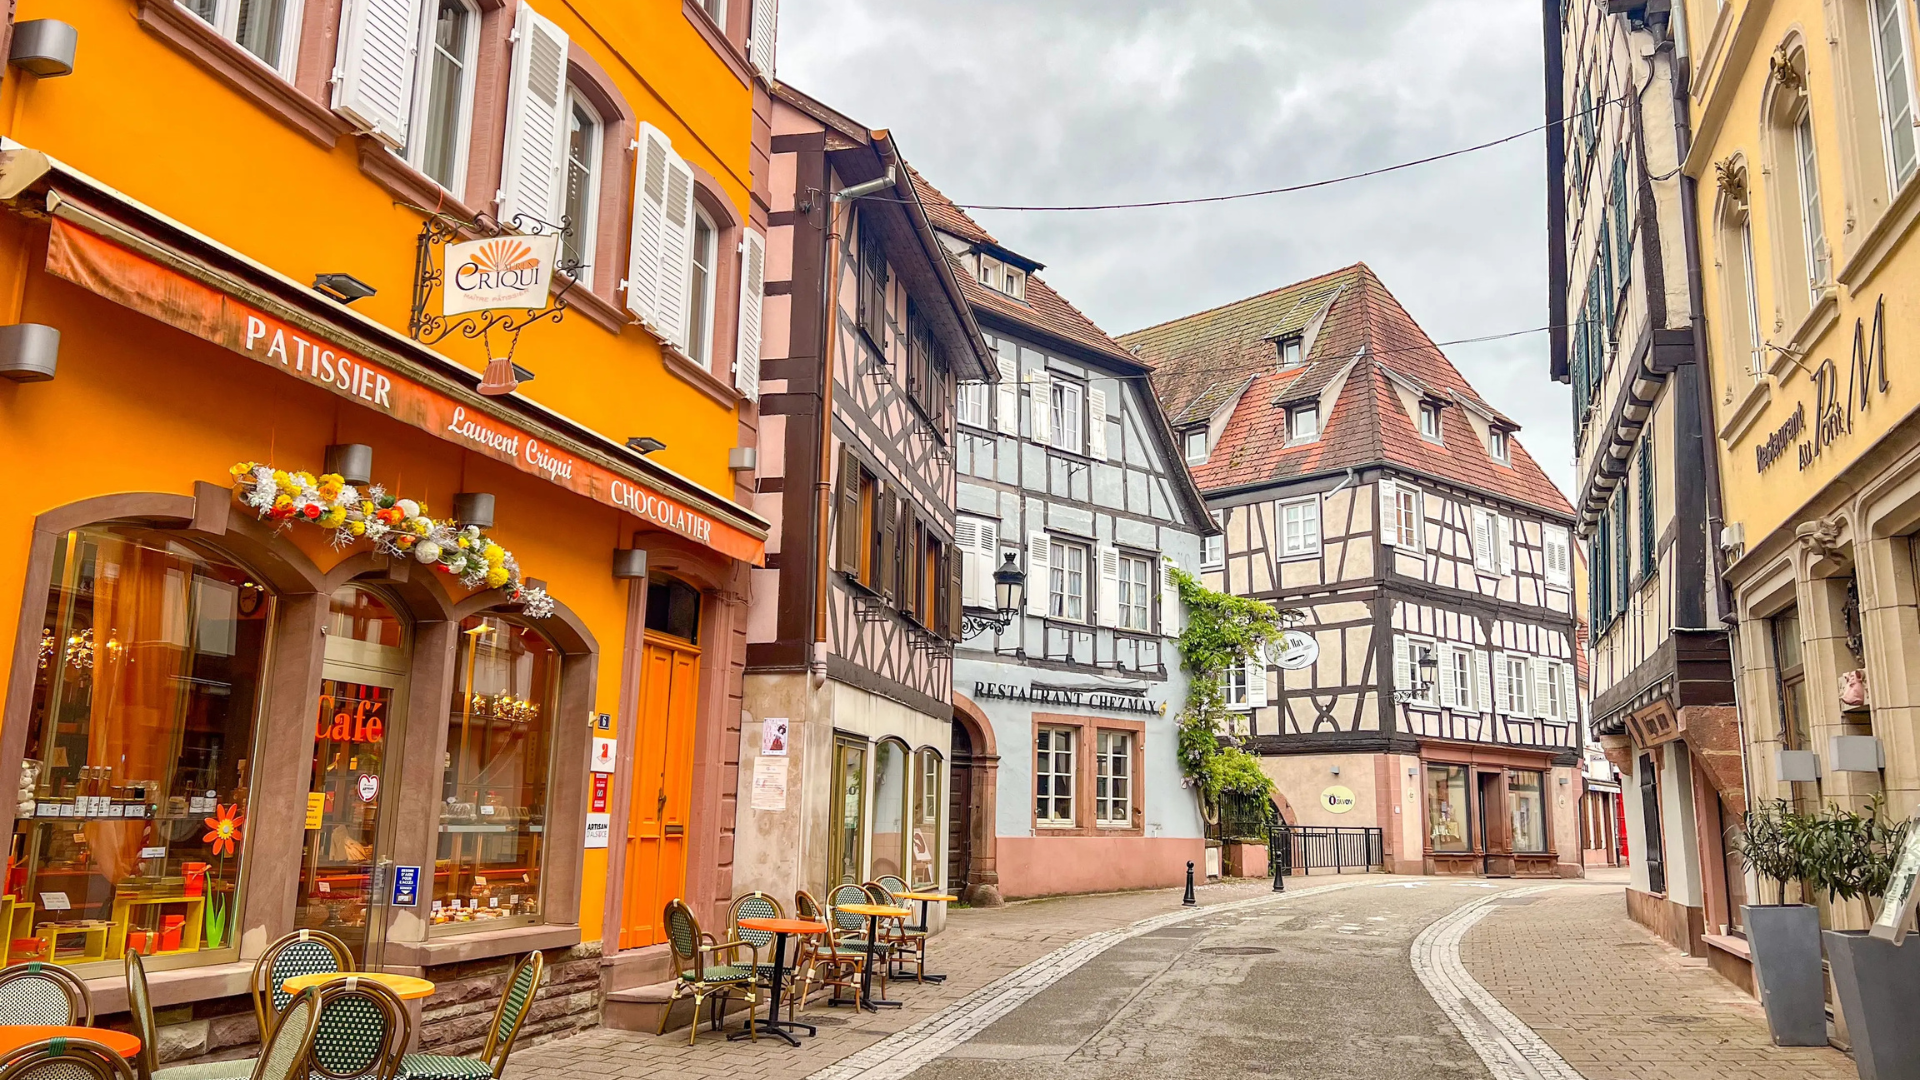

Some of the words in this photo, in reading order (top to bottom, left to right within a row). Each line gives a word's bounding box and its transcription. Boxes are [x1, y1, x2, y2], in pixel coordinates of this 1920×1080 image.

[455, 262, 540, 291] CRIQUI
[245, 315, 391, 409] PATISSIER
[447, 406, 519, 457] Laurent
[525, 439, 573, 480] Criqui
[1755, 401, 1806, 473] Restaurant
[610, 480, 711, 543] CHOCOLATIER
[315, 694, 383, 743] Café
[974, 681, 1084, 708] RESTAURANT
